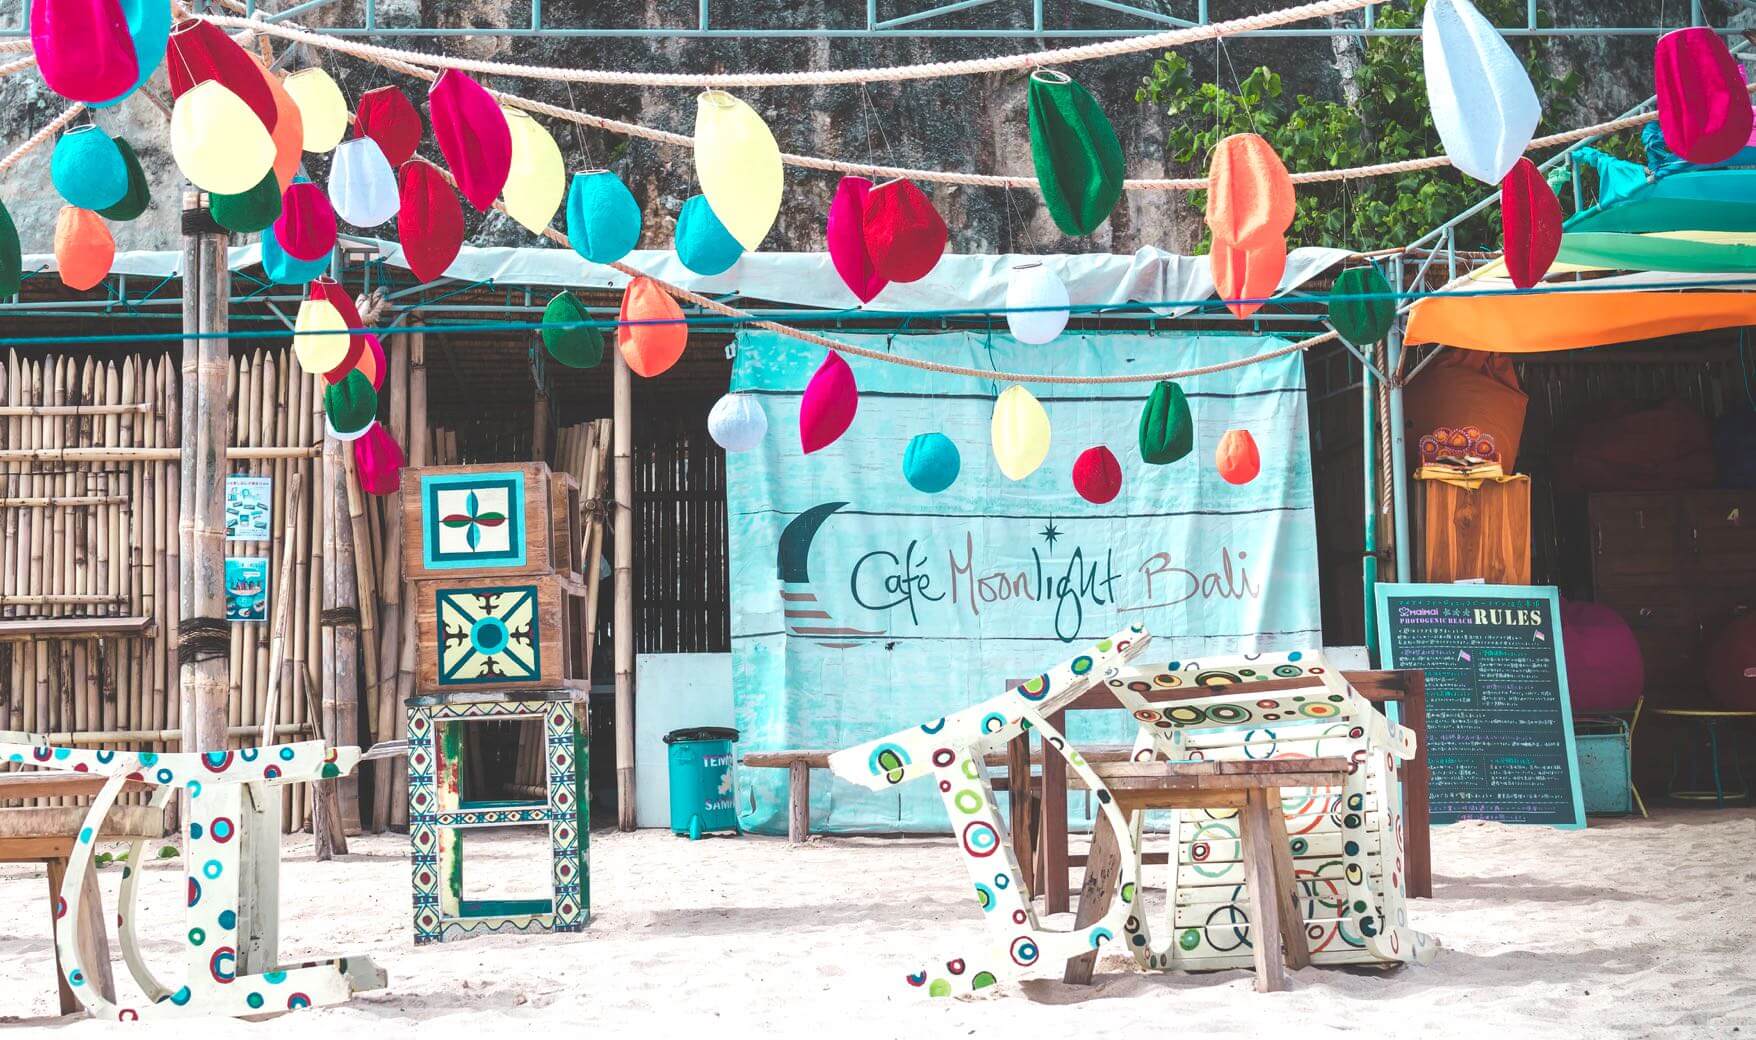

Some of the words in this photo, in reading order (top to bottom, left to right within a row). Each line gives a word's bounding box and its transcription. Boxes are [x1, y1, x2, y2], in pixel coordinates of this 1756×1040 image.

[850, 540, 945, 626] Café
[949, 530, 1122, 643] Moonlight
[1118, 547, 1260, 612] Bali
[1473, 608, 1542, 626] RULES
